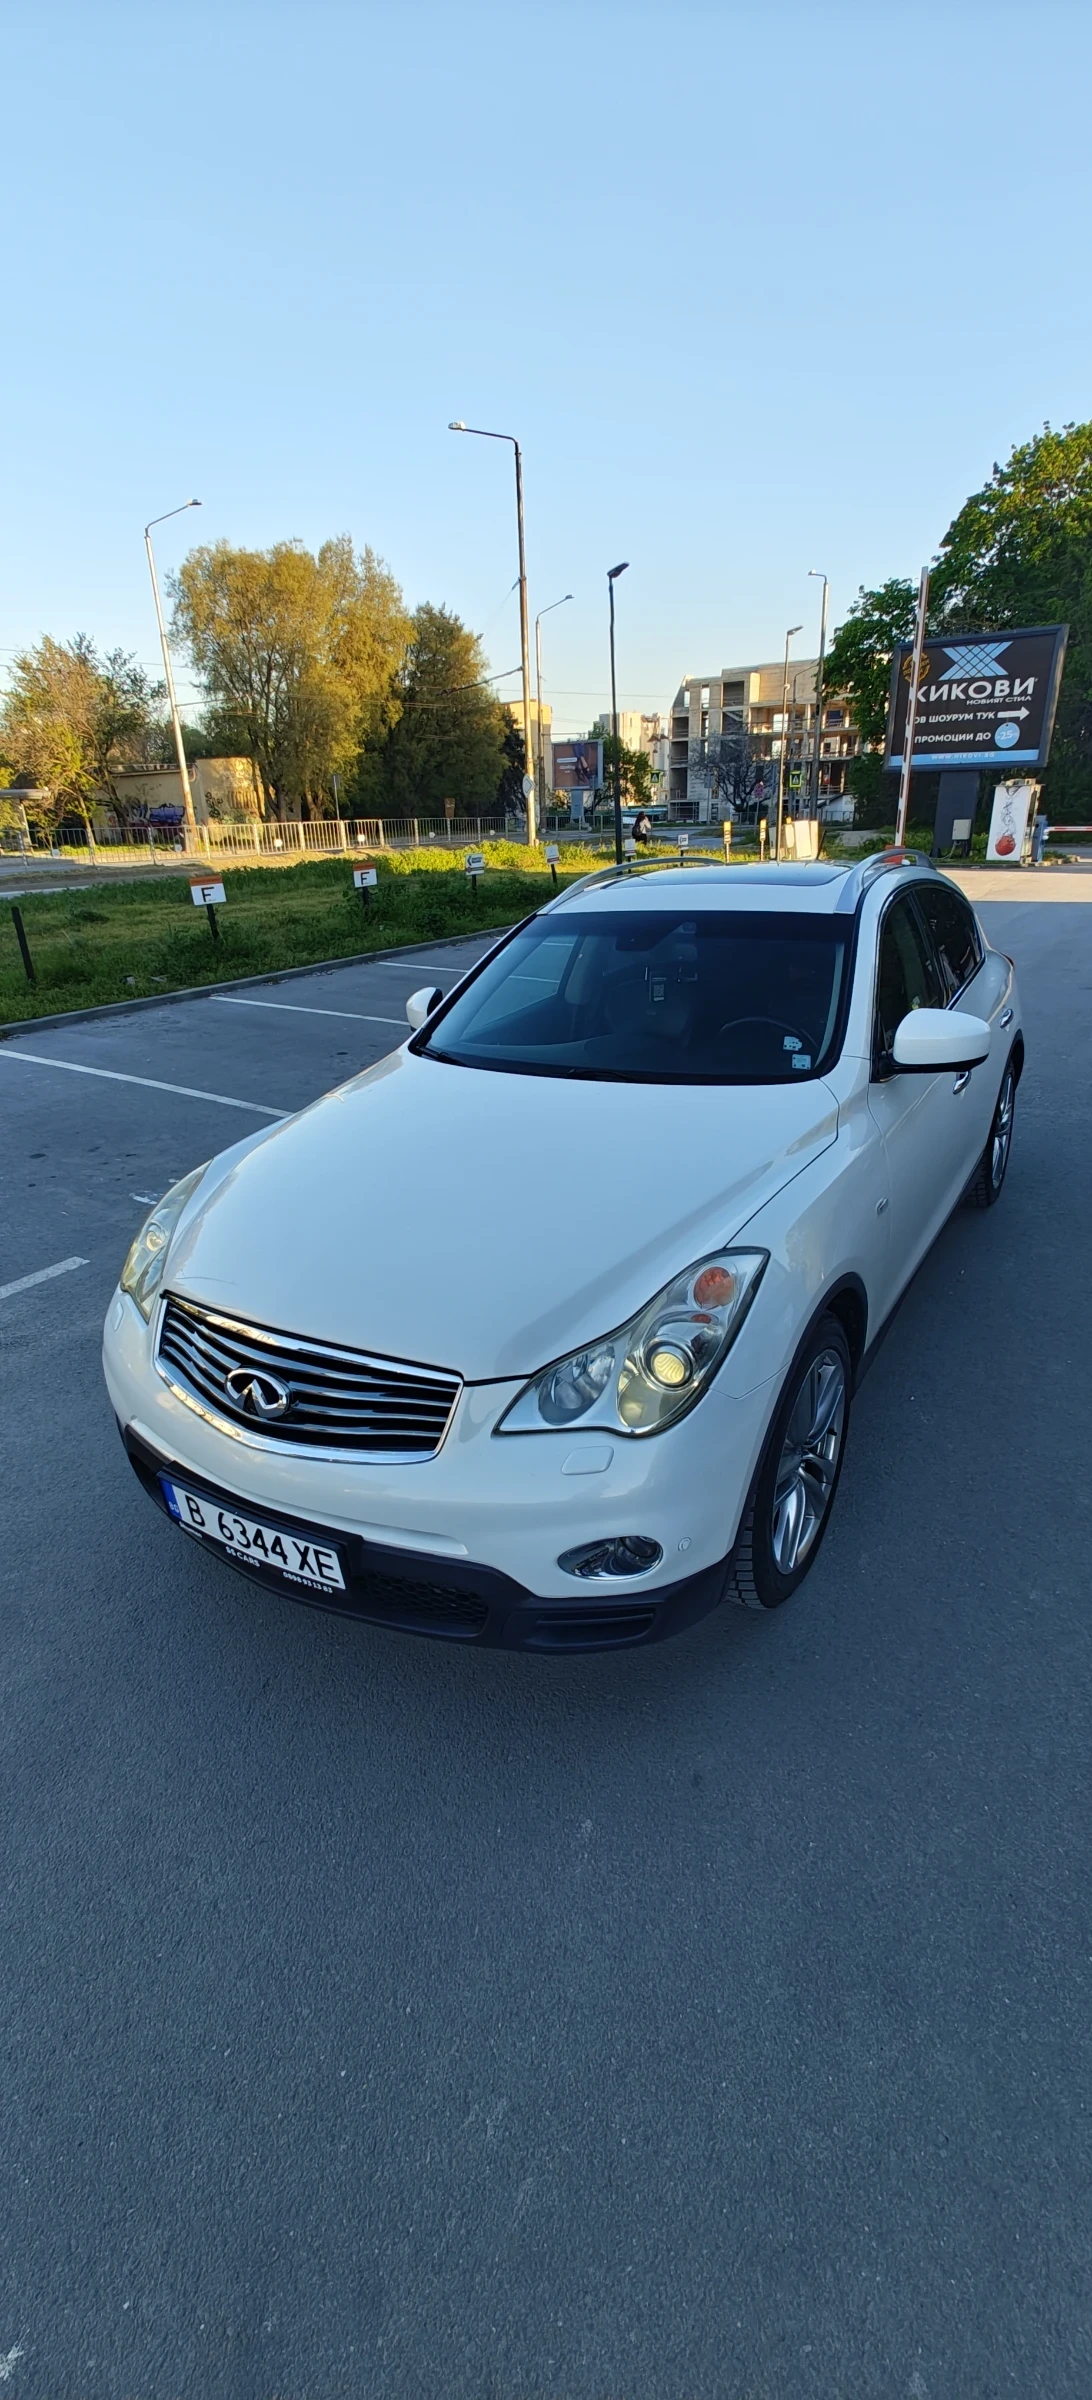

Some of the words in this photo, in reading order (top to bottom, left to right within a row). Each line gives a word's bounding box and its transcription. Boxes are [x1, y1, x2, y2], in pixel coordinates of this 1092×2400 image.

[966, 697, 1004, 706] НОВИЯТ
[1005, 695, 1032, 703] СТИЛ
[928, 712, 974, 723] ШОУРУМ
[975, 711, 996, 720] ТУК
[914, 732, 974, 744] ПРОМОЦИИ
[975, 732, 992, 742] ДО
[360, 871, 370, 885] F
[200, 886, 215, 903] F
[185, 1494, 206, 1527] B
[218, 1512, 288, 1566] 6344
[292, 1540, 339, 1584] XE
[236, 1551, 261, 1568] CARS
